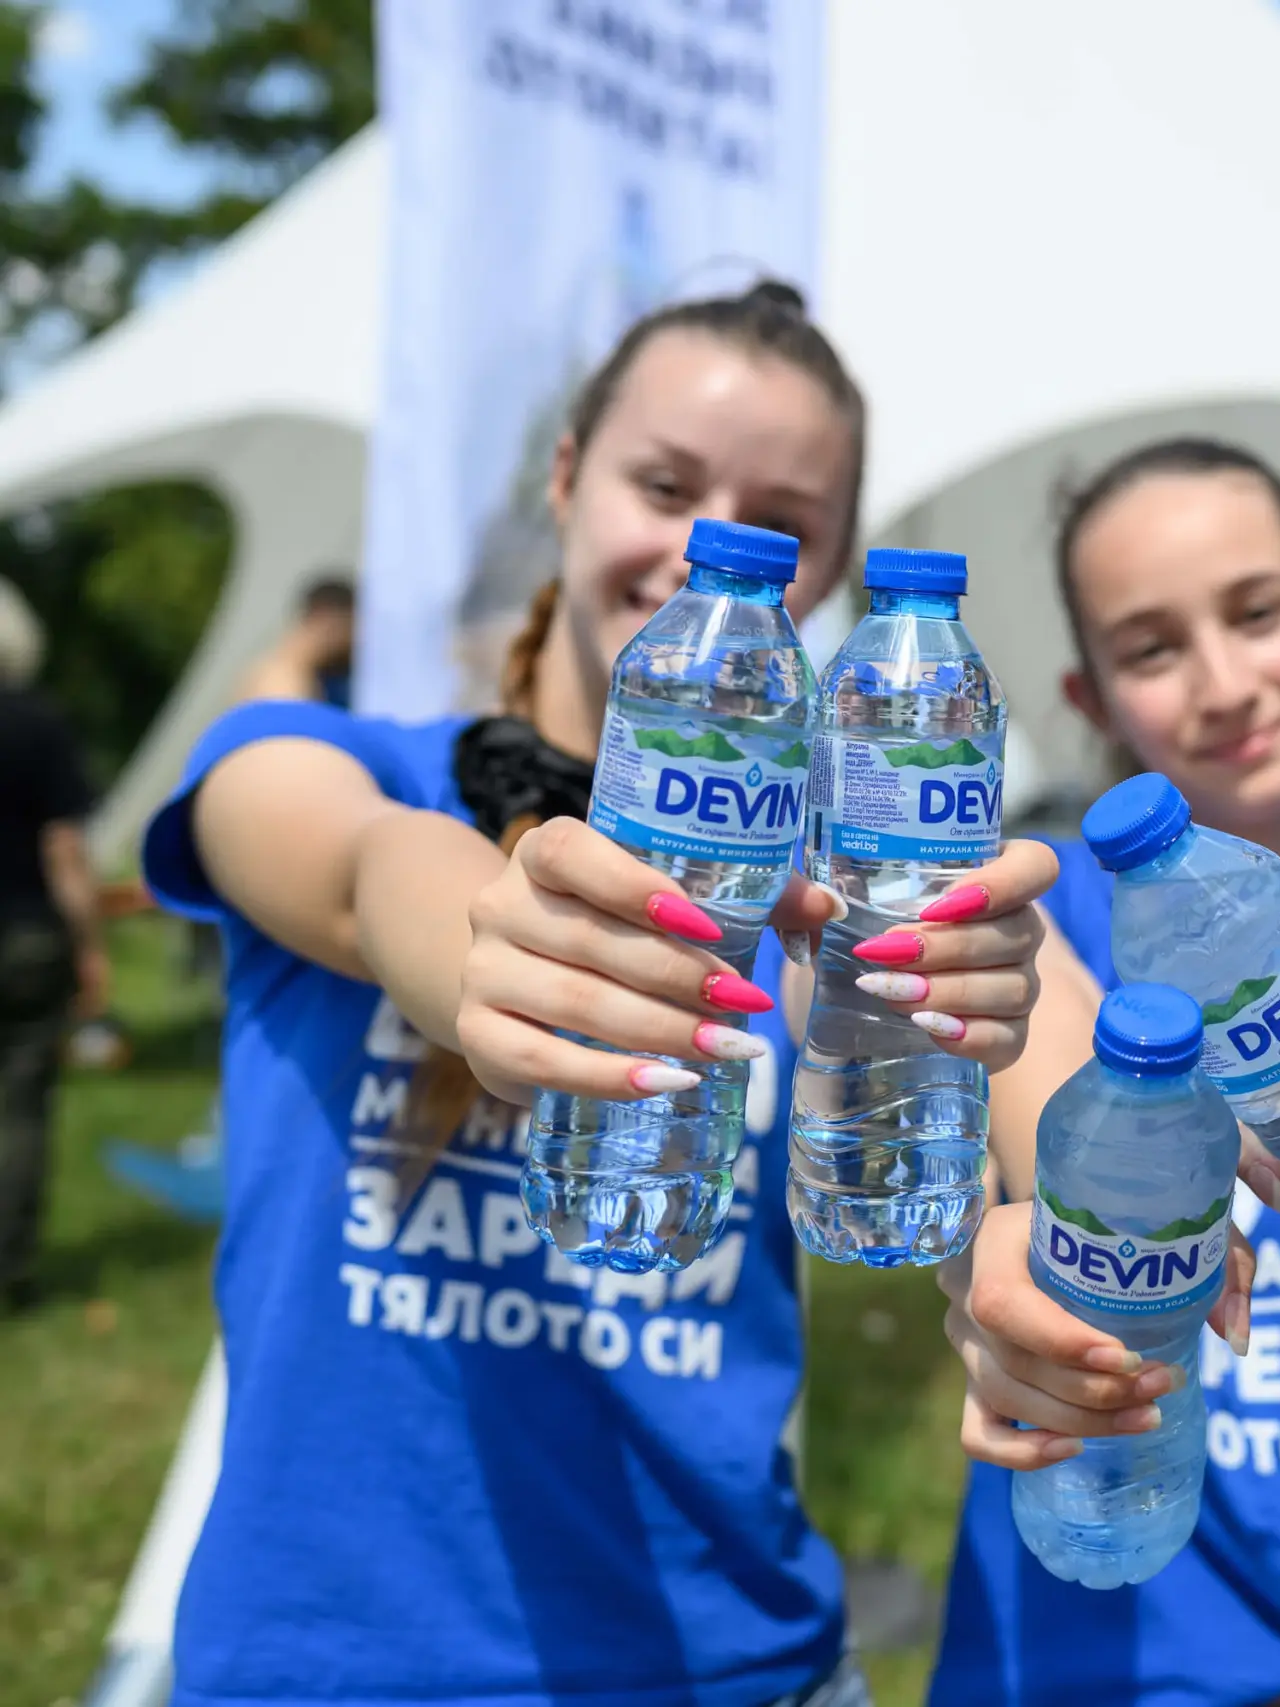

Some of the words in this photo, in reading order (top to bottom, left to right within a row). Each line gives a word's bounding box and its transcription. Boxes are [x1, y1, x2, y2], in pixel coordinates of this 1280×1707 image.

[654, 768, 803, 830] DEVIN
[651, 836, 714, 855] НАТУРАЛНА
[841, 839, 879, 853] vedri.bg
[920, 845, 972, 856] НАТУРАЛНА
[1050, 1223, 1199, 1289] DEVIN
[1122, 1245, 1131, 1256] 9
[1072, 1274, 1086, 1287] От
[1048, 1273, 1097, 1306] НАТУРАЛНА
[1100, 1301, 1162, 1312] МИНЕРАЛНА
[1164, 1295, 1191, 1309] ВОДА
[339, 1263, 632, 1372] ТЯЛОТО
[639, 1315, 724, 1381] СИ
